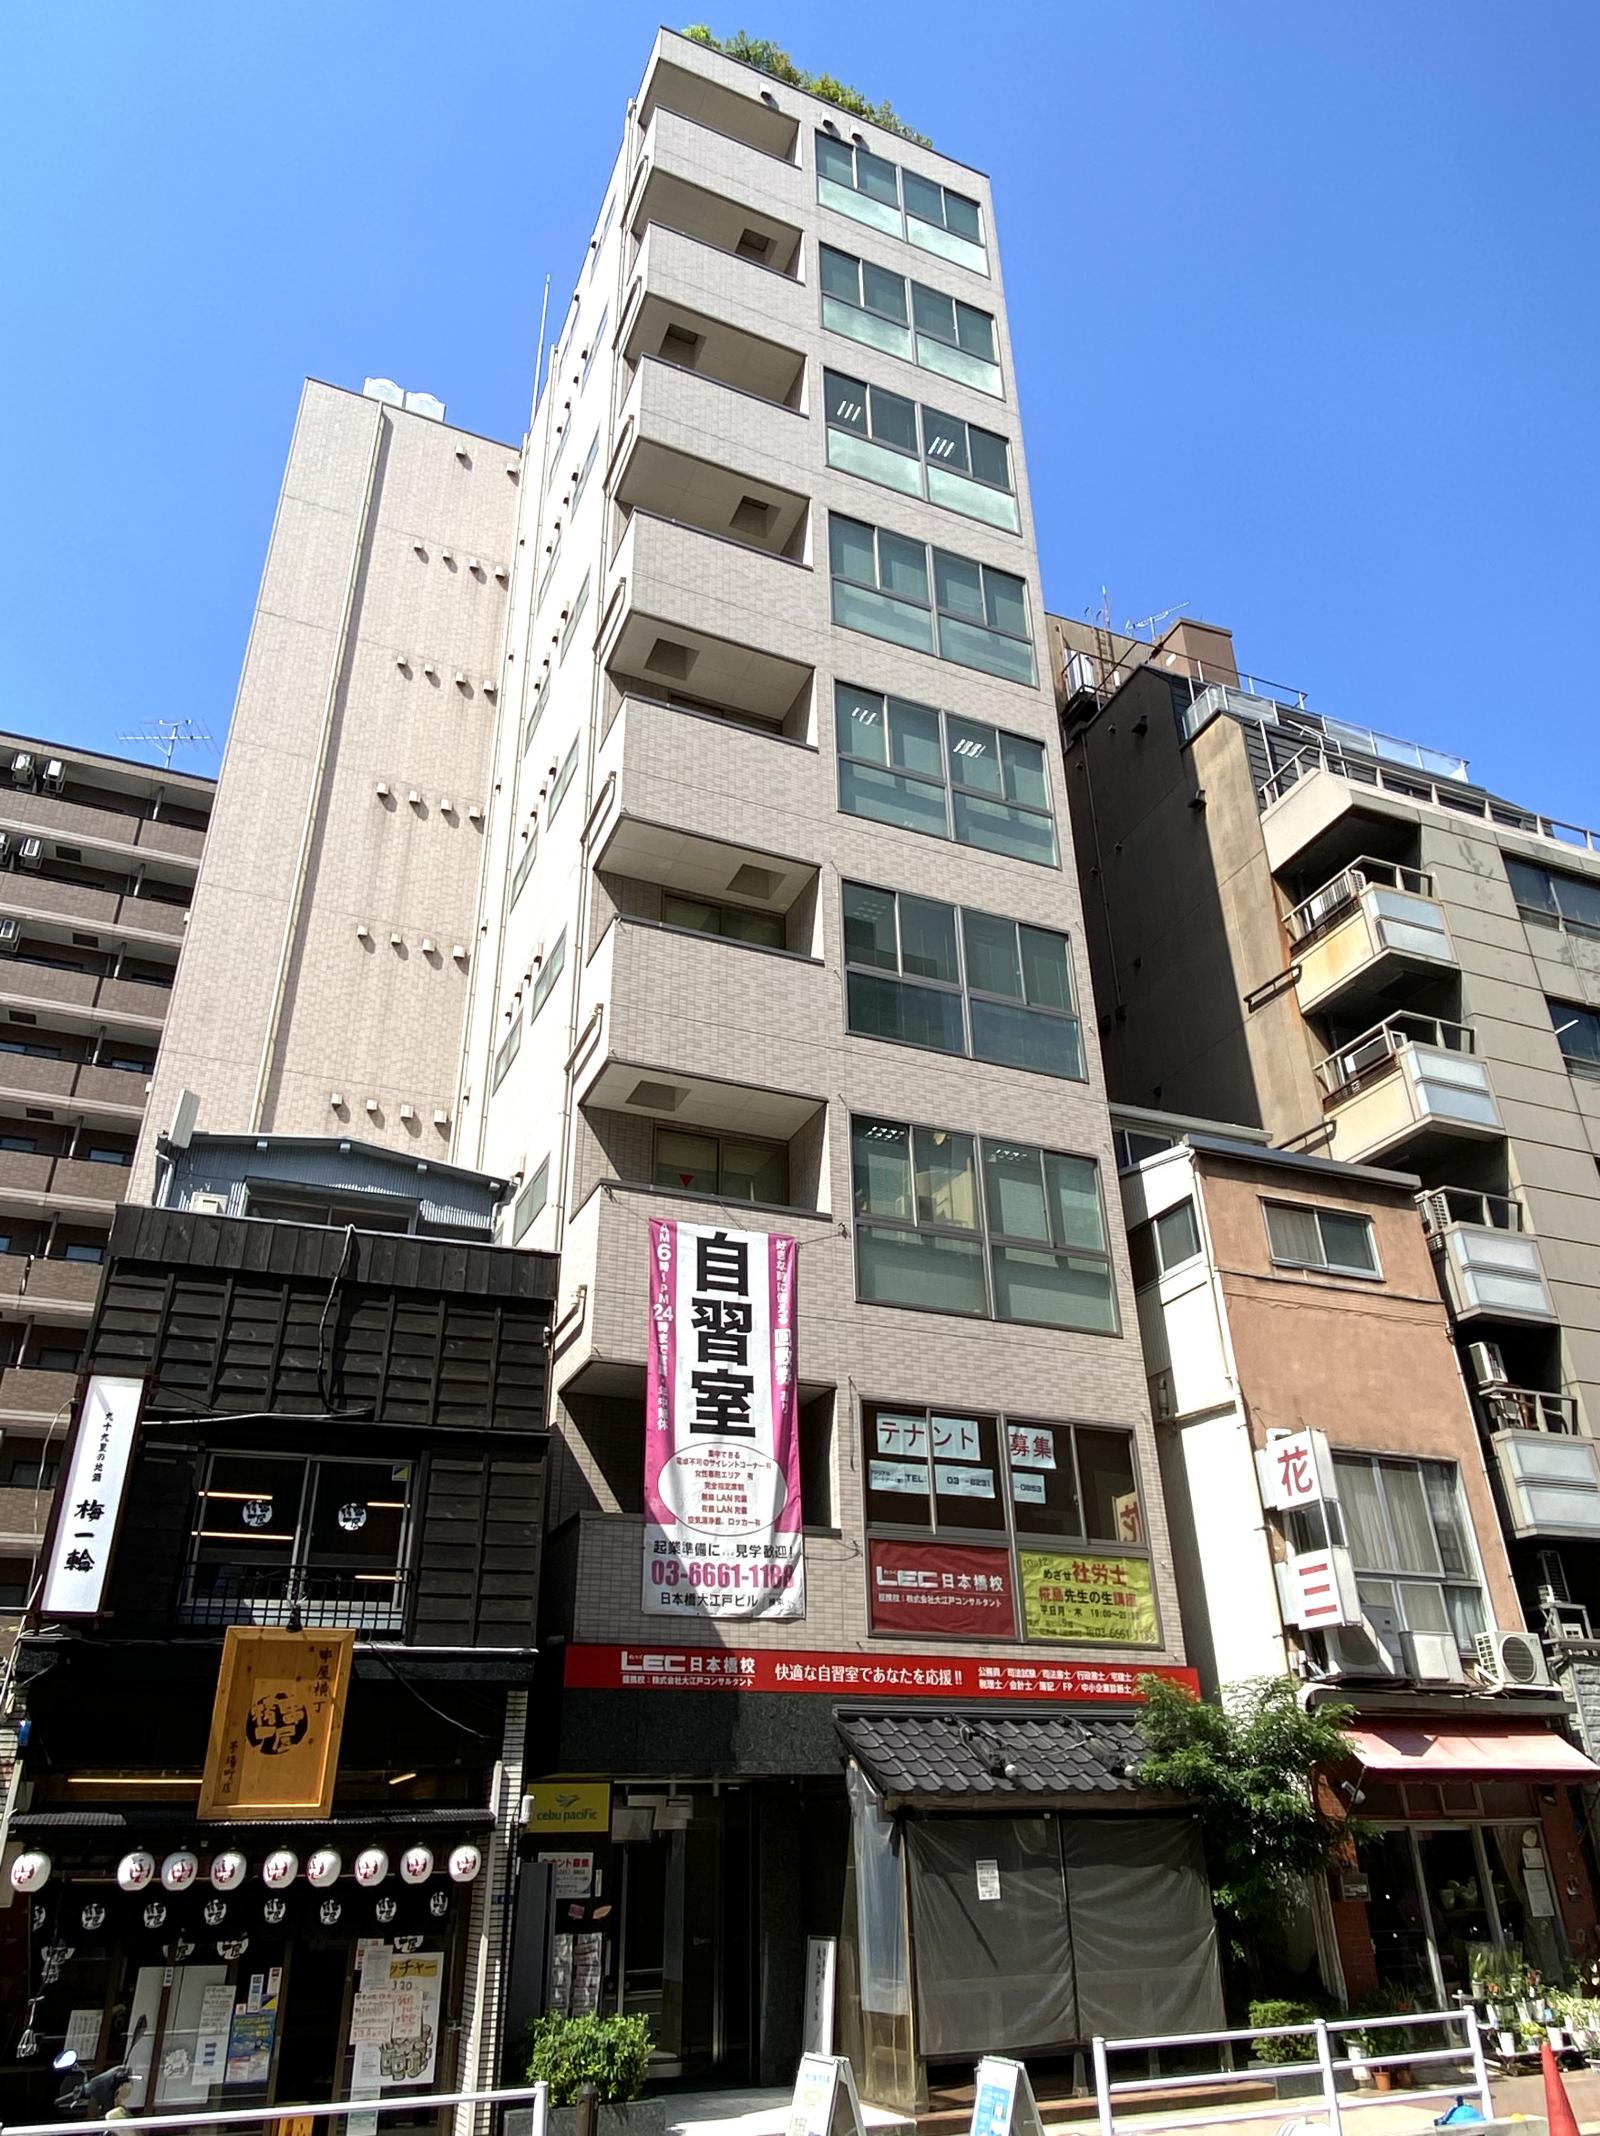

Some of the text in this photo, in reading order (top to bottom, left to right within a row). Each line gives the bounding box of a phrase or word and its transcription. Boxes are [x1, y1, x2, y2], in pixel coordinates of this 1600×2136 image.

[690, 1231, 756, 1437] 自習室
[879, 1421, 1052, 1459] テナント 募集
[716, 1494, 733, 1502] LAN
[716, 1505, 733, 1514] LAN
[64, 1499, 105, 1572] 梅一輪
[1277, 1446, 1338, 1617] 花 三
[876, 1566, 1003, 1592] LEC 日本橋校
[661, 1592, 758, 1607] 日本橋大江戸ビル
[621, 1651, 755, 1674] LEC 日本橋校
[312, 1648, 334, 1713] 串屋横丁
[537, 1808, 598, 1823] cebu pacific
